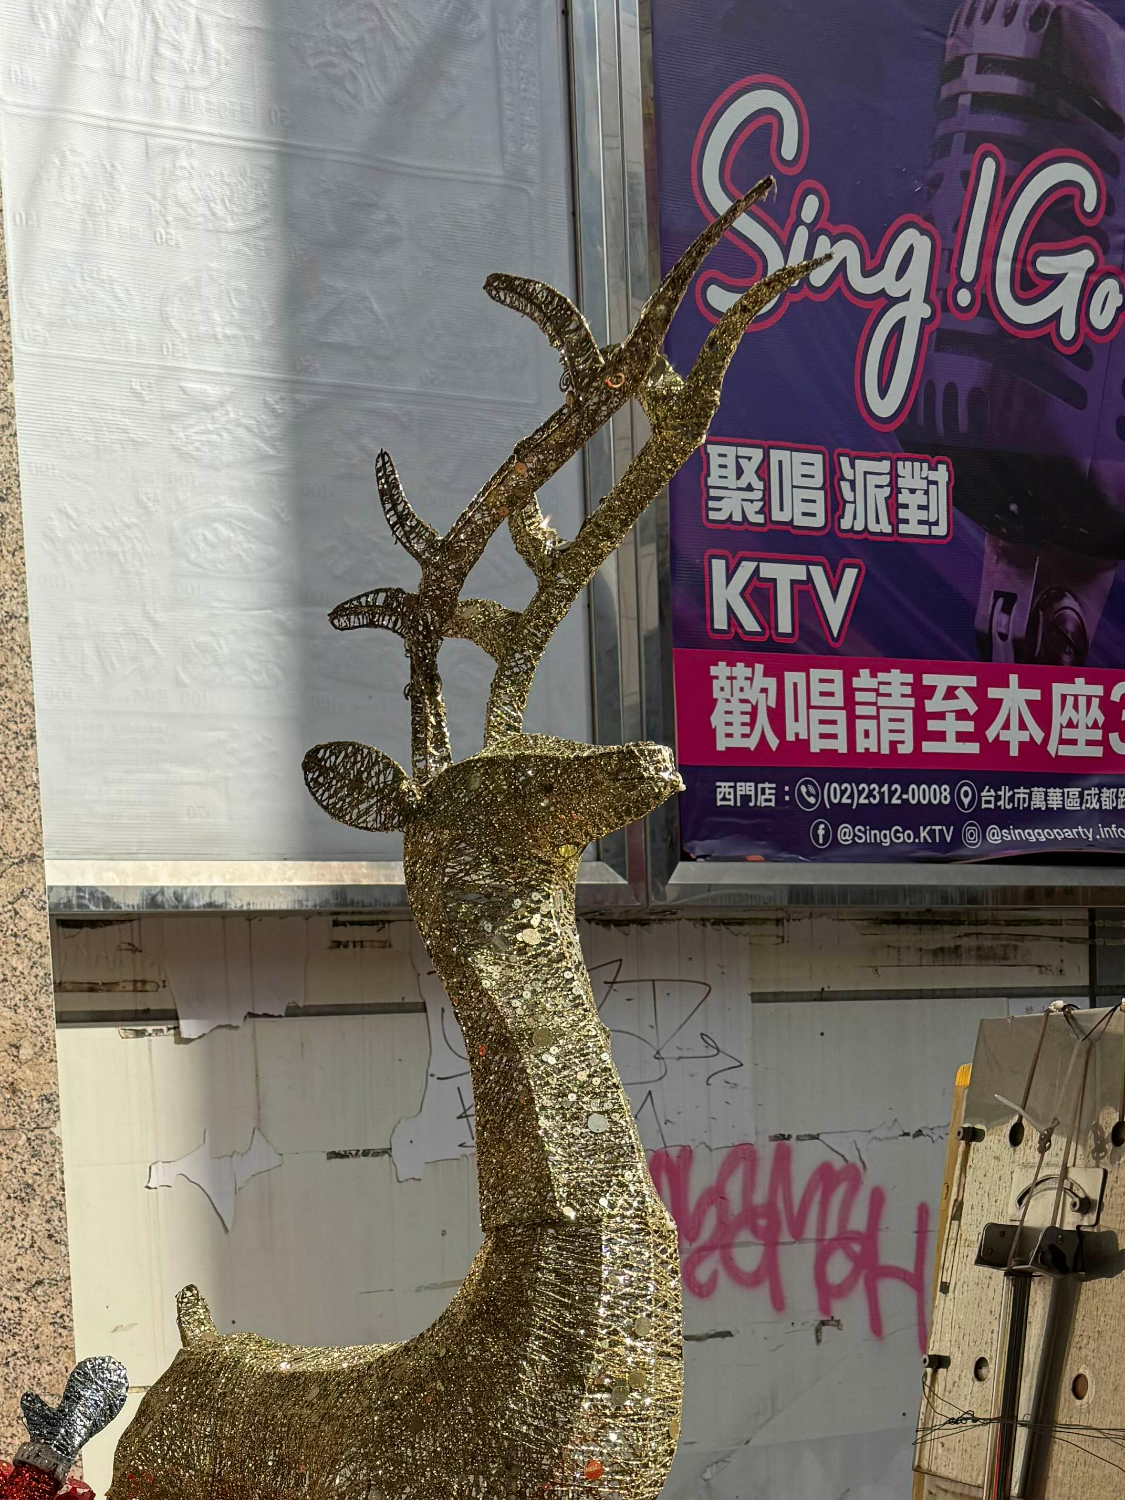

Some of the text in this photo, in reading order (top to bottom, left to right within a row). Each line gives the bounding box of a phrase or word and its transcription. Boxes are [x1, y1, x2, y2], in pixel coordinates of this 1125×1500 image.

[707, 557, 860, 640] KTV
[823, 782, 951, 810] (02)2312-0008
[836, 825, 954, 847] @SingGo.KTV
